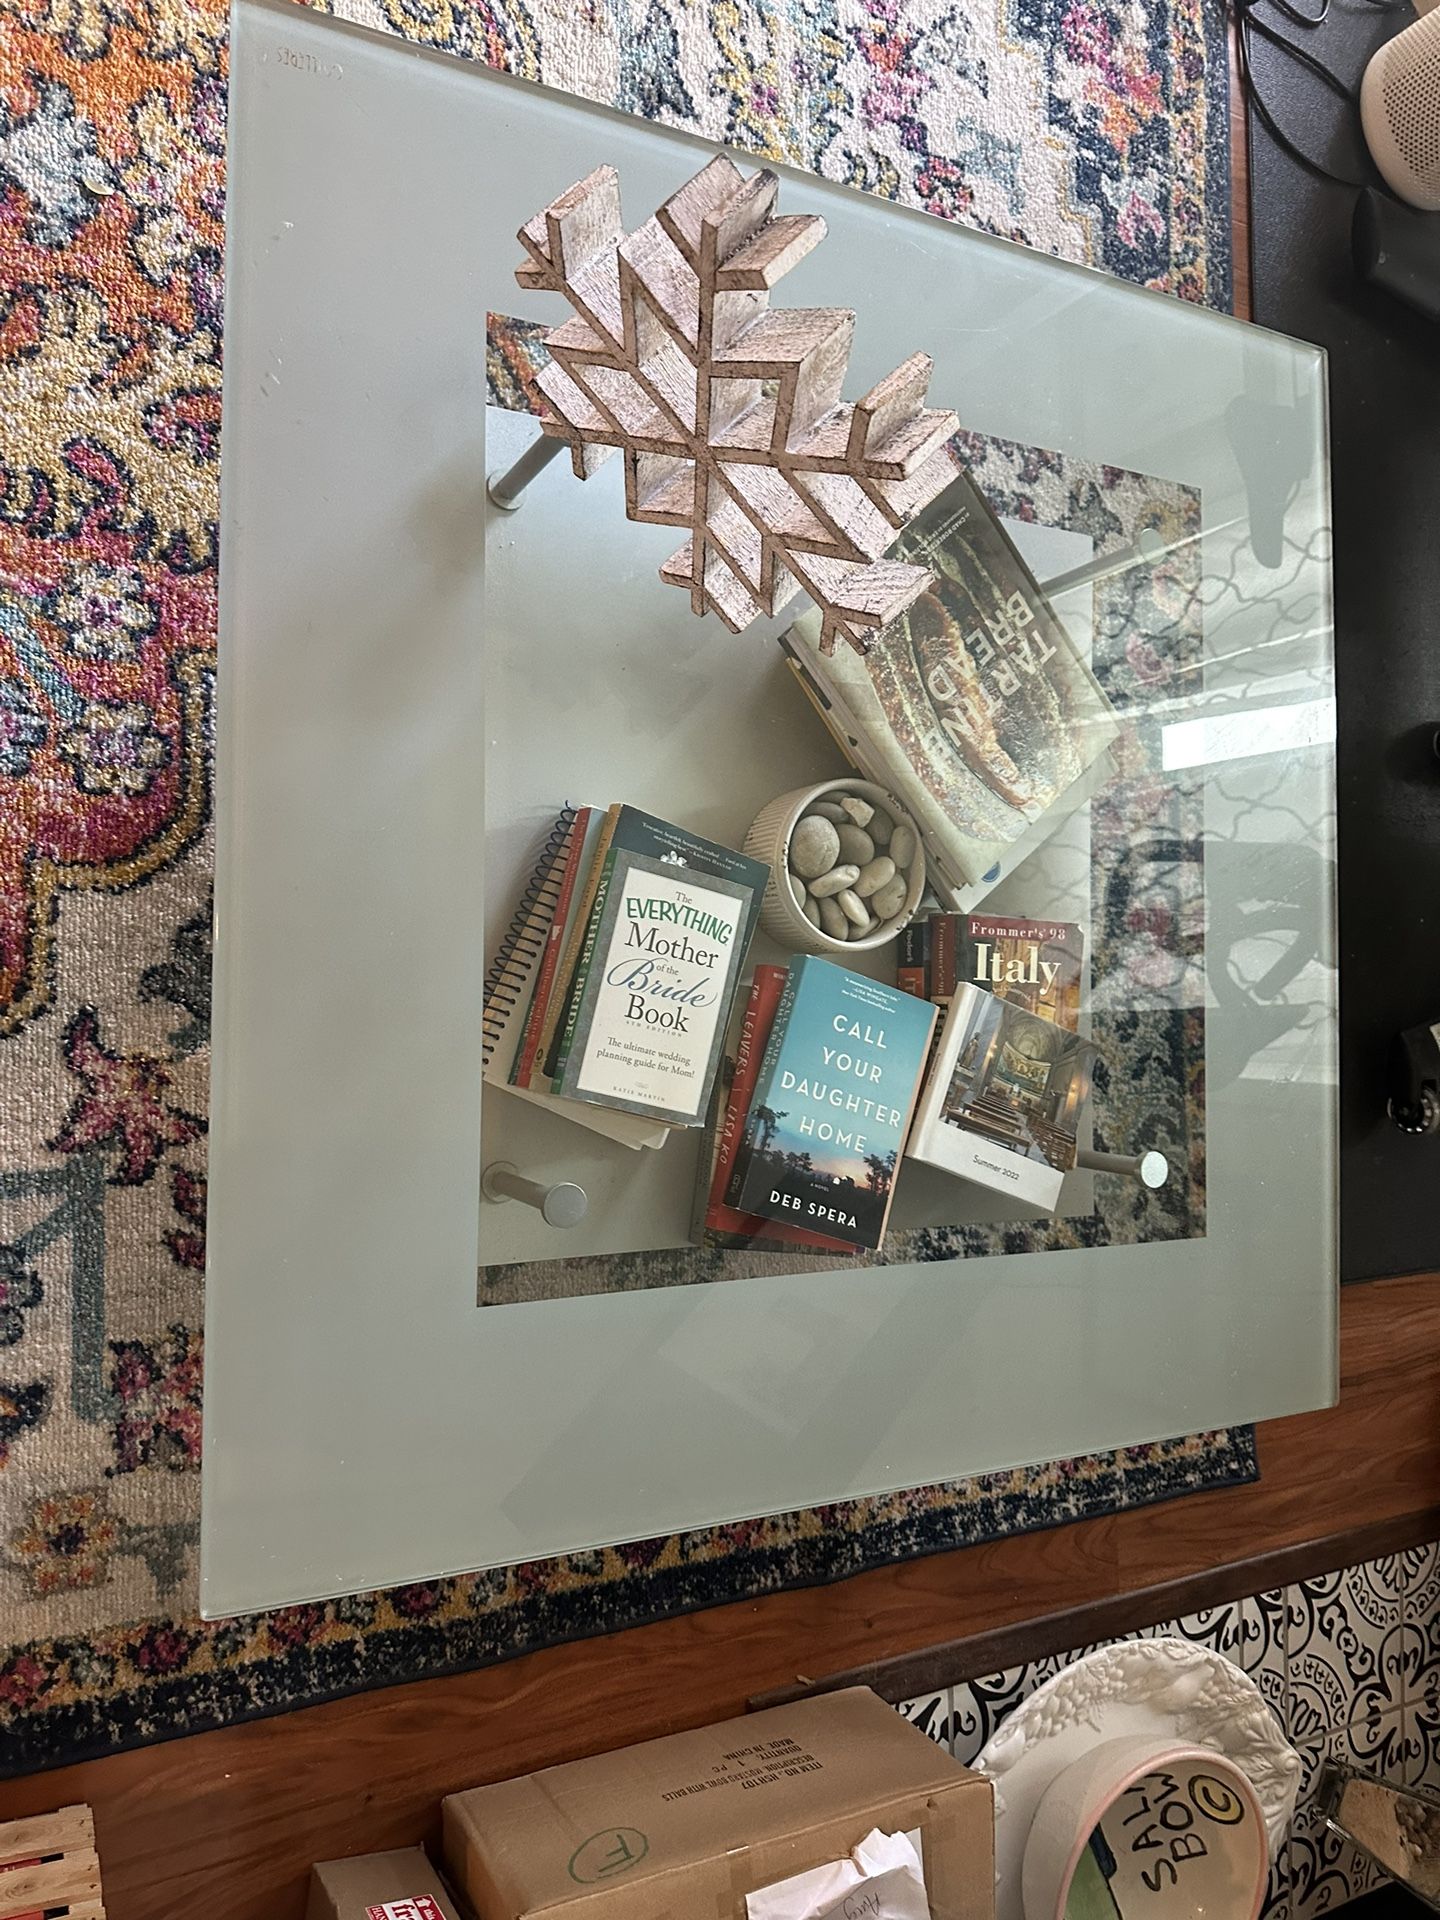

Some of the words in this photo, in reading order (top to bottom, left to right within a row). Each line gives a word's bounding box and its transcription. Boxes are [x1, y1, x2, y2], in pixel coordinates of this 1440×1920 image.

[951, 516, 966, 530] CHAD
[928, 590, 1035, 701] BREAD
[675, 891, 692, 904] The
[581, 880, 608, 964] MOTHER
[626, 897, 733, 944] EVERYTHING
[971, 921, 1043, 939] Frommer's
[624, 920, 719, 968] Mother
[607, 957, 718, 1008] Bride
[656, 964, 666, 972] of
[666, 965, 679, 975] the
[973, 942, 1062, 995] Italy
[564, 977, 585, 1037] BRIDE
[752, 984, 760, 1000] THE
[770, 973, 795, 1041] DAUGHTER
[781, 992, 795, 1023] CALL
[624, 993, 690, 1032] Book
[735, 1011, 757, 1075] LEAVERS
[771, 1030, 785, 1065] YOUR
[833, 1015, 887, 1049] CALL
[596, 1048, 632, 1065] planning
[633, 1058, 656, 1069] guide
[657, 1062, 670, 1072] for
[671, 1065, 695, 1078] Mom!
[608, 1036, 621, 1047] The
[623, 1042, 656, 1056] ultimate
[658, 1051, 691, 1066] wedding
[760, 1047, 773, 1083] HOME
[823, 1046, 883, 1084] YOUR
[780, 1071, 901, 1128] DAUGHTER
[724, 1105, 738, 1138] LISA
[799, 1116, 868, 1154] HOME
[720, 1143, 730, 1165] KO
[972, 1155, 1001, 1175] Summer
[1001, 1167, 1020, 1181] 2022
[769, 1190, 802, 1211] DEB
[807, 1203, 858, 1229] SPERA
[722, 1748, 754, 1761] CHINA
[753, 1744, 765, 1752] IN
[769, 1738, 795, 1750] MADE
[709, 1777, 730, 1789] BOWL
[711, 1764, 728, 1774] PC
[728, 1768, 765, 1784] MUSTARD
[801, 1761, 824, 1774] ITEM
[661, 1788, 688, 1802] BALLS
[687, 1781, 708, 1795] WITH
[598, 1833, 635, 1873] F
